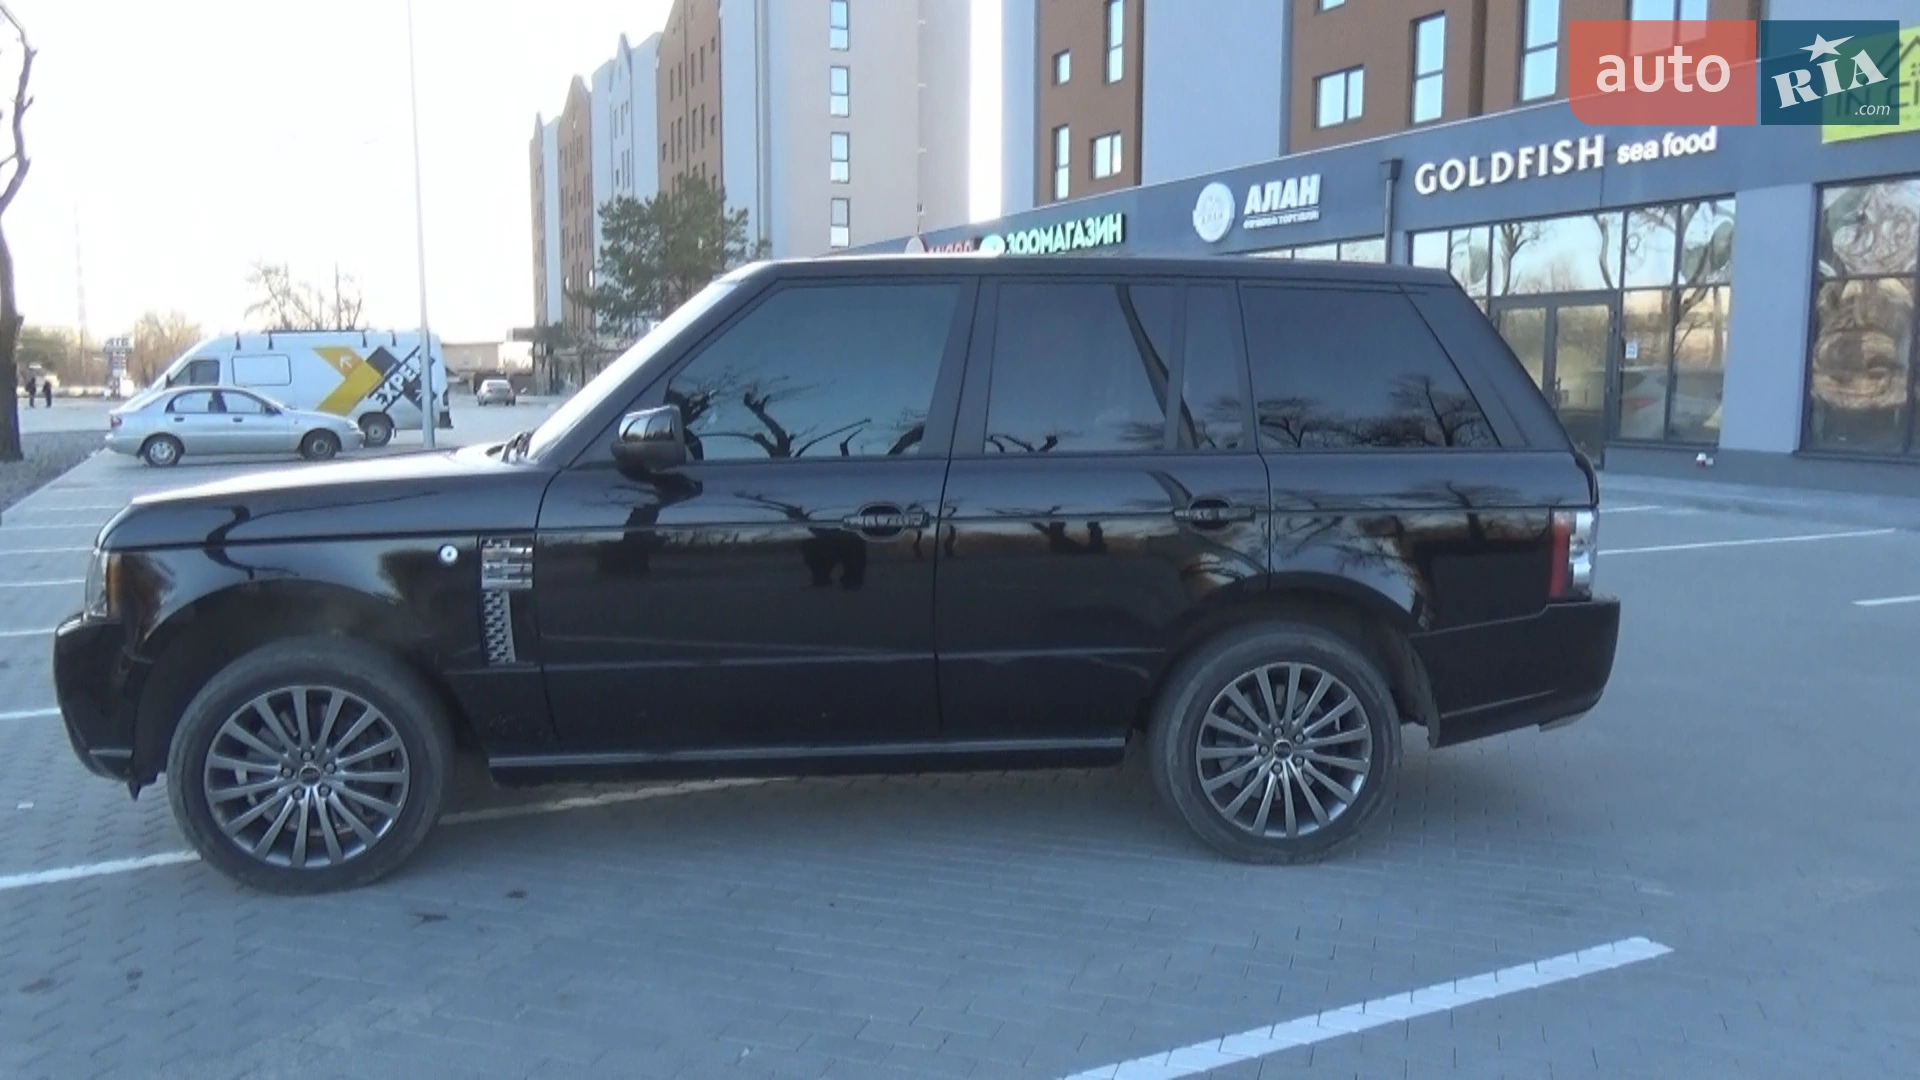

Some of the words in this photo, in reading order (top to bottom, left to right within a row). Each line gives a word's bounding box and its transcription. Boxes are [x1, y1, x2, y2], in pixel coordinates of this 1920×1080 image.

[1414, 134, 1606, 195] GOLDFISH
[1617, 138, 1659, 165] sea
[1661, 125, 1718, 156] food
[1243, 173, 1321, 215] АЛАН
[1006, 213, 1123, 254] ЗООМАГАЗИН
